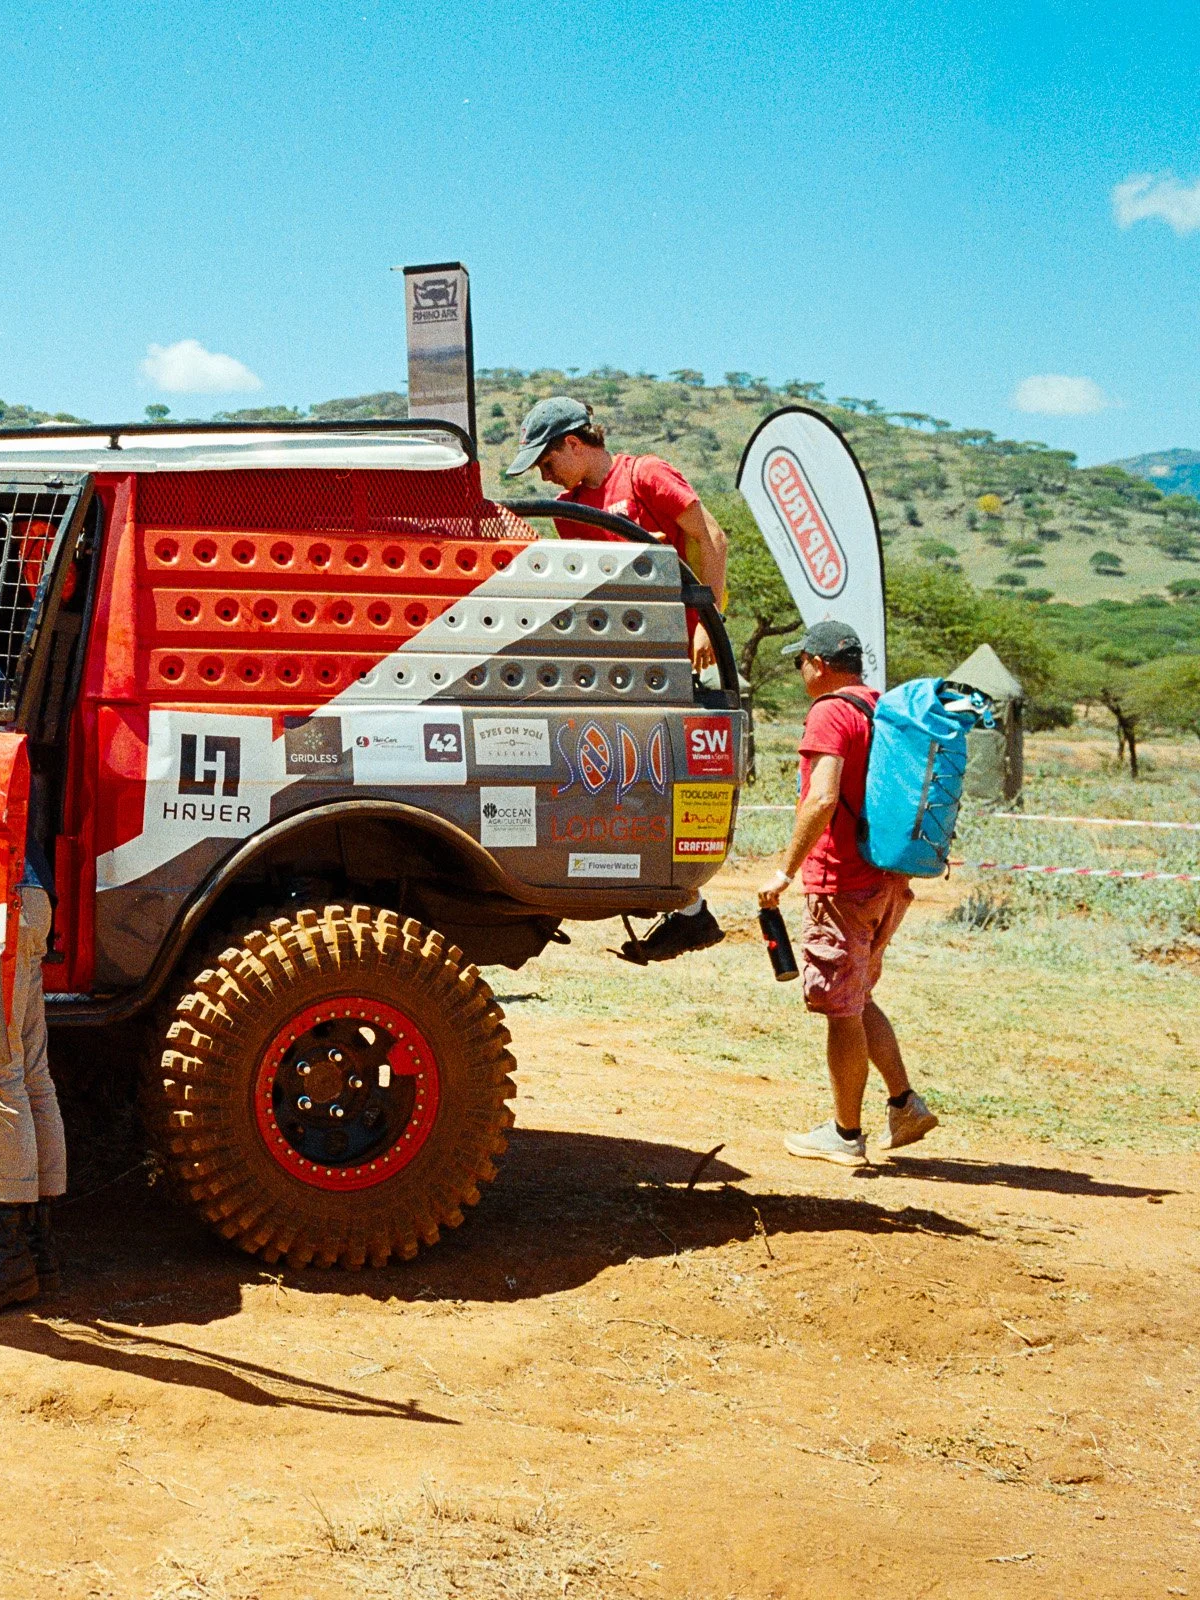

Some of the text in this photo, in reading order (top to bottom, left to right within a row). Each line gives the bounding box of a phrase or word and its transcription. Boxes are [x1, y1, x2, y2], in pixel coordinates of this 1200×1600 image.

[412, 308, 458, 321] RHINO ARK
[504, 726, 519, 735] ON
[523, 727, 543, 740] YOU
[429, 733, 458, 753] 42
[691, 729, 728, 752] SW
[290, 753, 338, 763] GRIDLESS
[680, 790, 729, 799] TOOLCRAFTS
[163, 802, 251, 823] HAYER
[498, 808, 531, 818] OCEAN
[551, 815, 668, 842] LODGES
[588, 861, 638, 870] FlowerWatch
